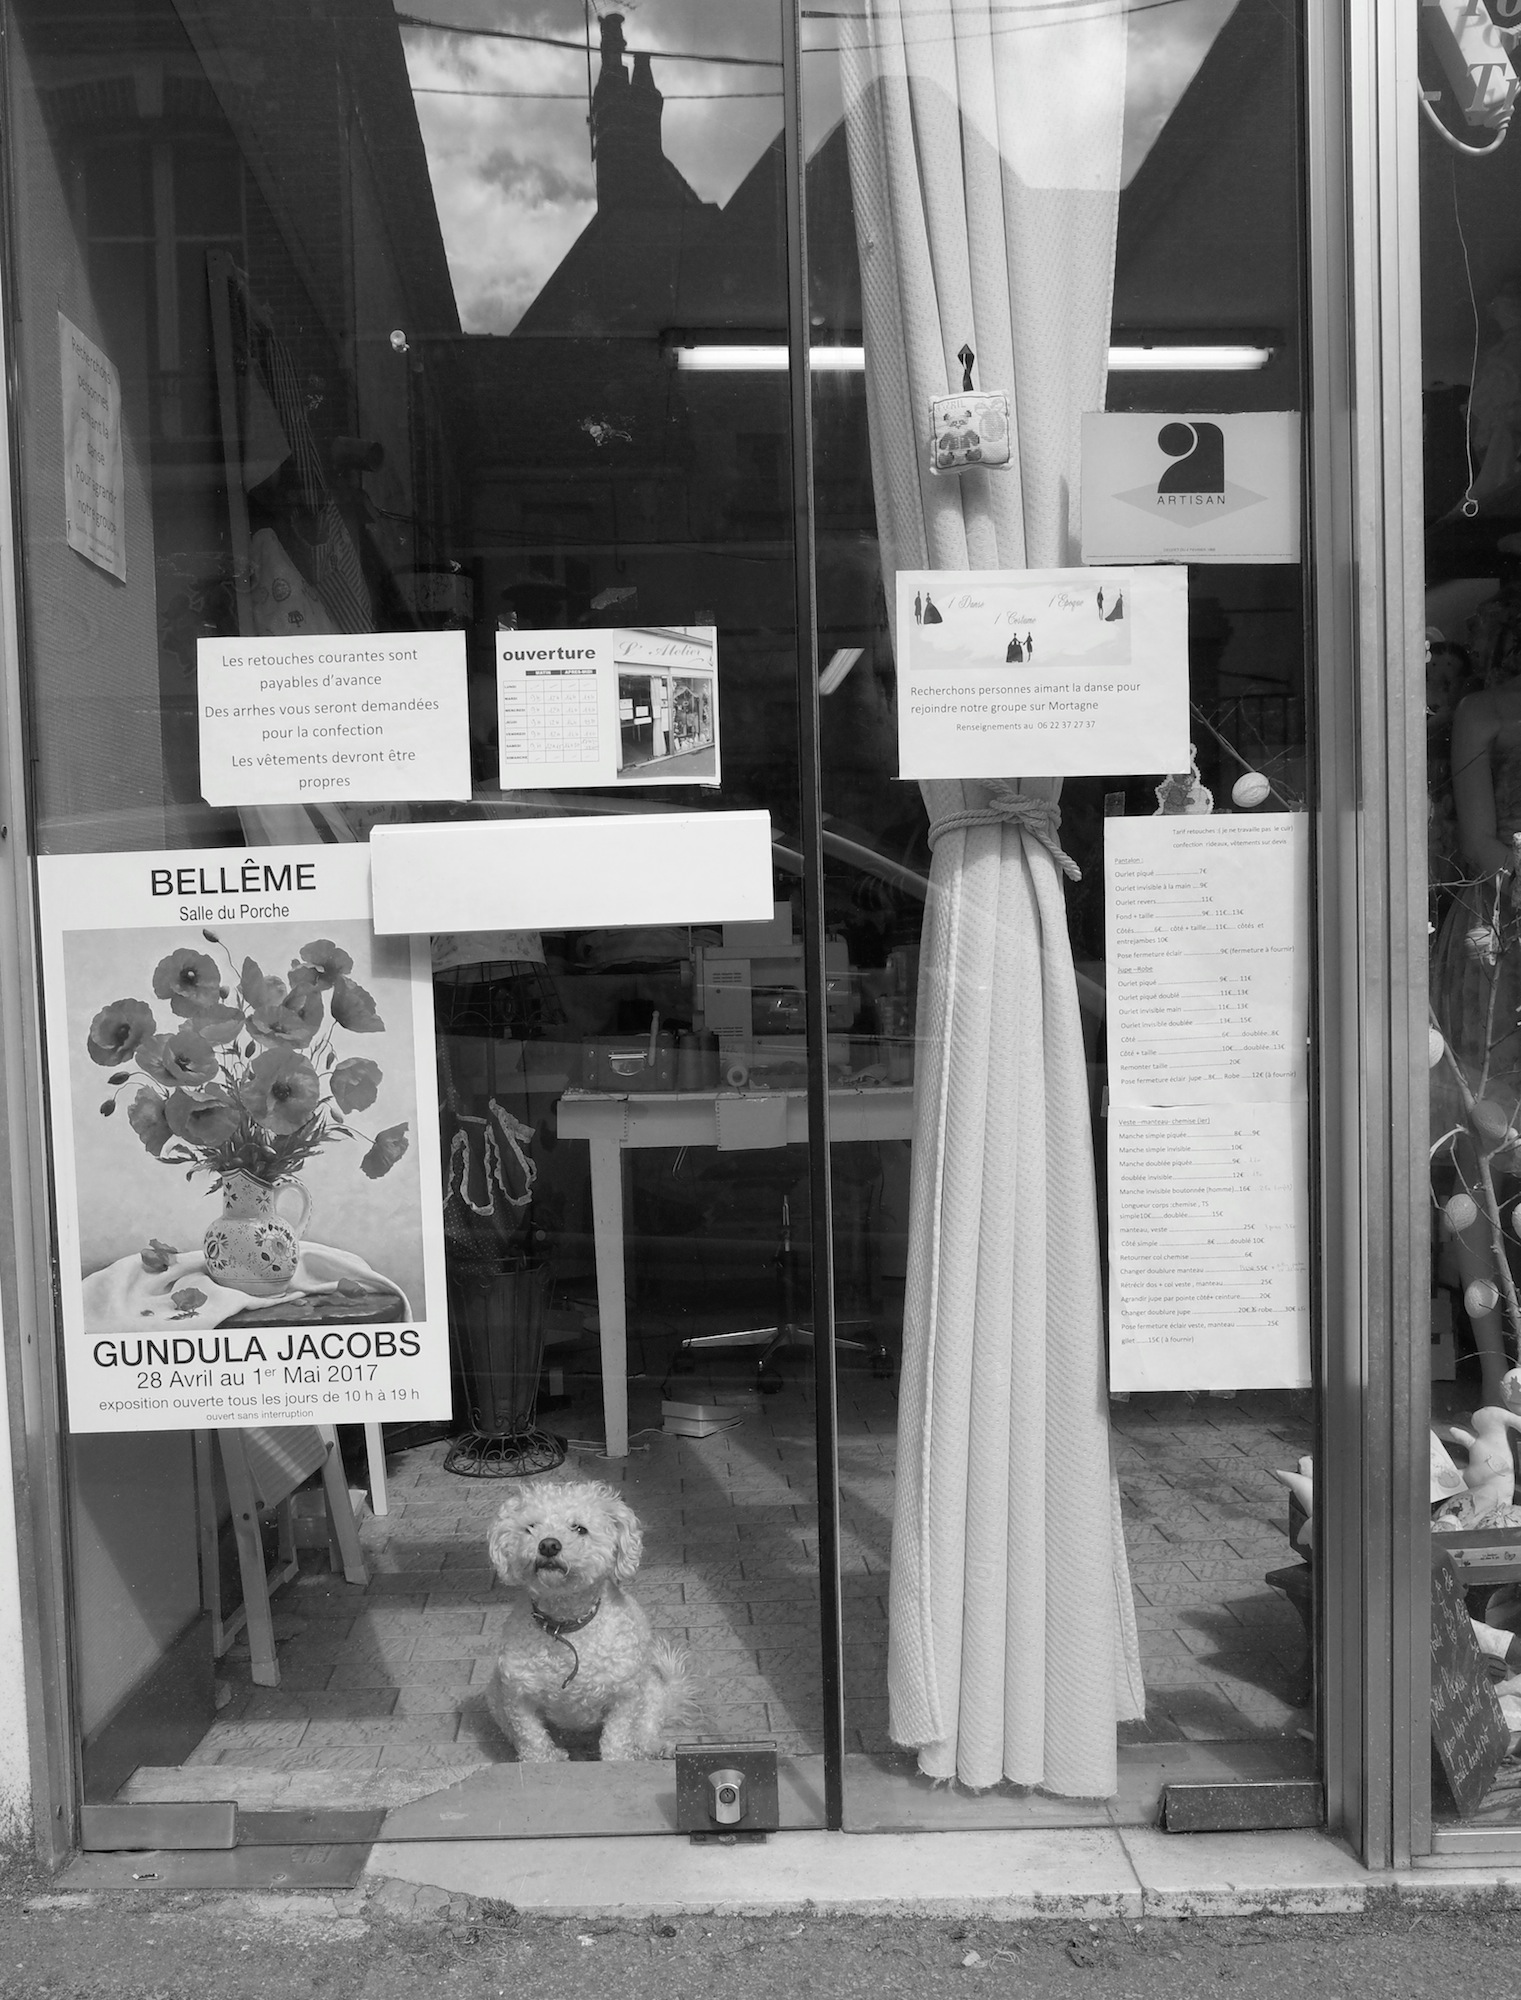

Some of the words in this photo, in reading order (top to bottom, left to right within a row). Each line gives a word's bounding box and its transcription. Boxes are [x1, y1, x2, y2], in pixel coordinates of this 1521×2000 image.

[1157, 495, 1225, 505] ARTISAN
[1006, 612, 1037, 625] Costume
[223, 656, 243, 667] Les
[248, 653, 314, 666] retouches
[319, 651, 384, 663] courantes
[389, 650, 417, 661] sont
[503, 647, 595, 661] ouverture
[261, 676, 318, 691] payables
[323, 674, 381, 686] d’avance
[911, 686, 975, 696] Recherchons
[979, 687, 1031, 696] personnes
[1034, 684, 1069, 693] aimant
[1073, 683, 1080, 692] la
[1084, 683, 1113, 692] danse
[1117, 684, 1140, 693] pour
[205, 706, 229, 717] Des
[233, 704, 275, 717] arrhes
[279, 706, 310, 715] vous
[315, 702, 356, 714] seront
[362, 698, 439, 712] demandées
[911, 704, 957, 715] rejoindre
[961, 704, 988, 712] notre
[991, 704, 1027, 714] groupe
[1049, 702, 1098, 712] Mortagne
[263, 730, 293, 741] pour
[298, 726, 308, 737] la
[313, 724, 383, 737] confection
[957, 723, 1021, 732] Renseignements
[1050, 721, 1059, 729] 22
[232, 756, 253, 767] Les
[257, 754, 327, 766] vêtements
[332, 751, 384, 763] devront
[389, 749, 415, 761] être
[299, 778, 350, 790] propres
[151, 859, 316, 896] BELLÊME
[180, 906, 213, 921] Salle
[218, 905, 235, 919] du
[240, 903, 289, 918] Porche
[1270, 945, 1295, 953] fournir)
[1170, 1335, 1194, 1344] fournir)
[94, 1336, 267, 1369] GUNDULA
[278, 1330, 420, 1361] JACOBS
[138, 1372, 162, 1388] 28
[170, 1370, 212, 1387] Avril
[221, 1373, 244, 1386] au
[254, 1368, 276, 1384] 1er
[285, 1366, 319, 1383] Mai
[328, 1365, 377, 1382] 2017
[99, 1398, 168, 1412] exposition
[173, 1396, 223, 1408] ouverte
[228, 1396, 257, 1406] tous
[262, 1394, 281, 1405] les
[285, 1393, 318, 1407] jours
[323, 1391, 339, 1402] de
[345, 1390, 360, 1401] 10
[365, 1390, 373, 1401] h
[378, 1389, 386, 1401] à
[391, 1389, 406, 1400] 19
[412, 1389, 419, 1399] h
[206, 1413, 235, 1421] ouvert
[262, 1406, 313, 1419] interruption
